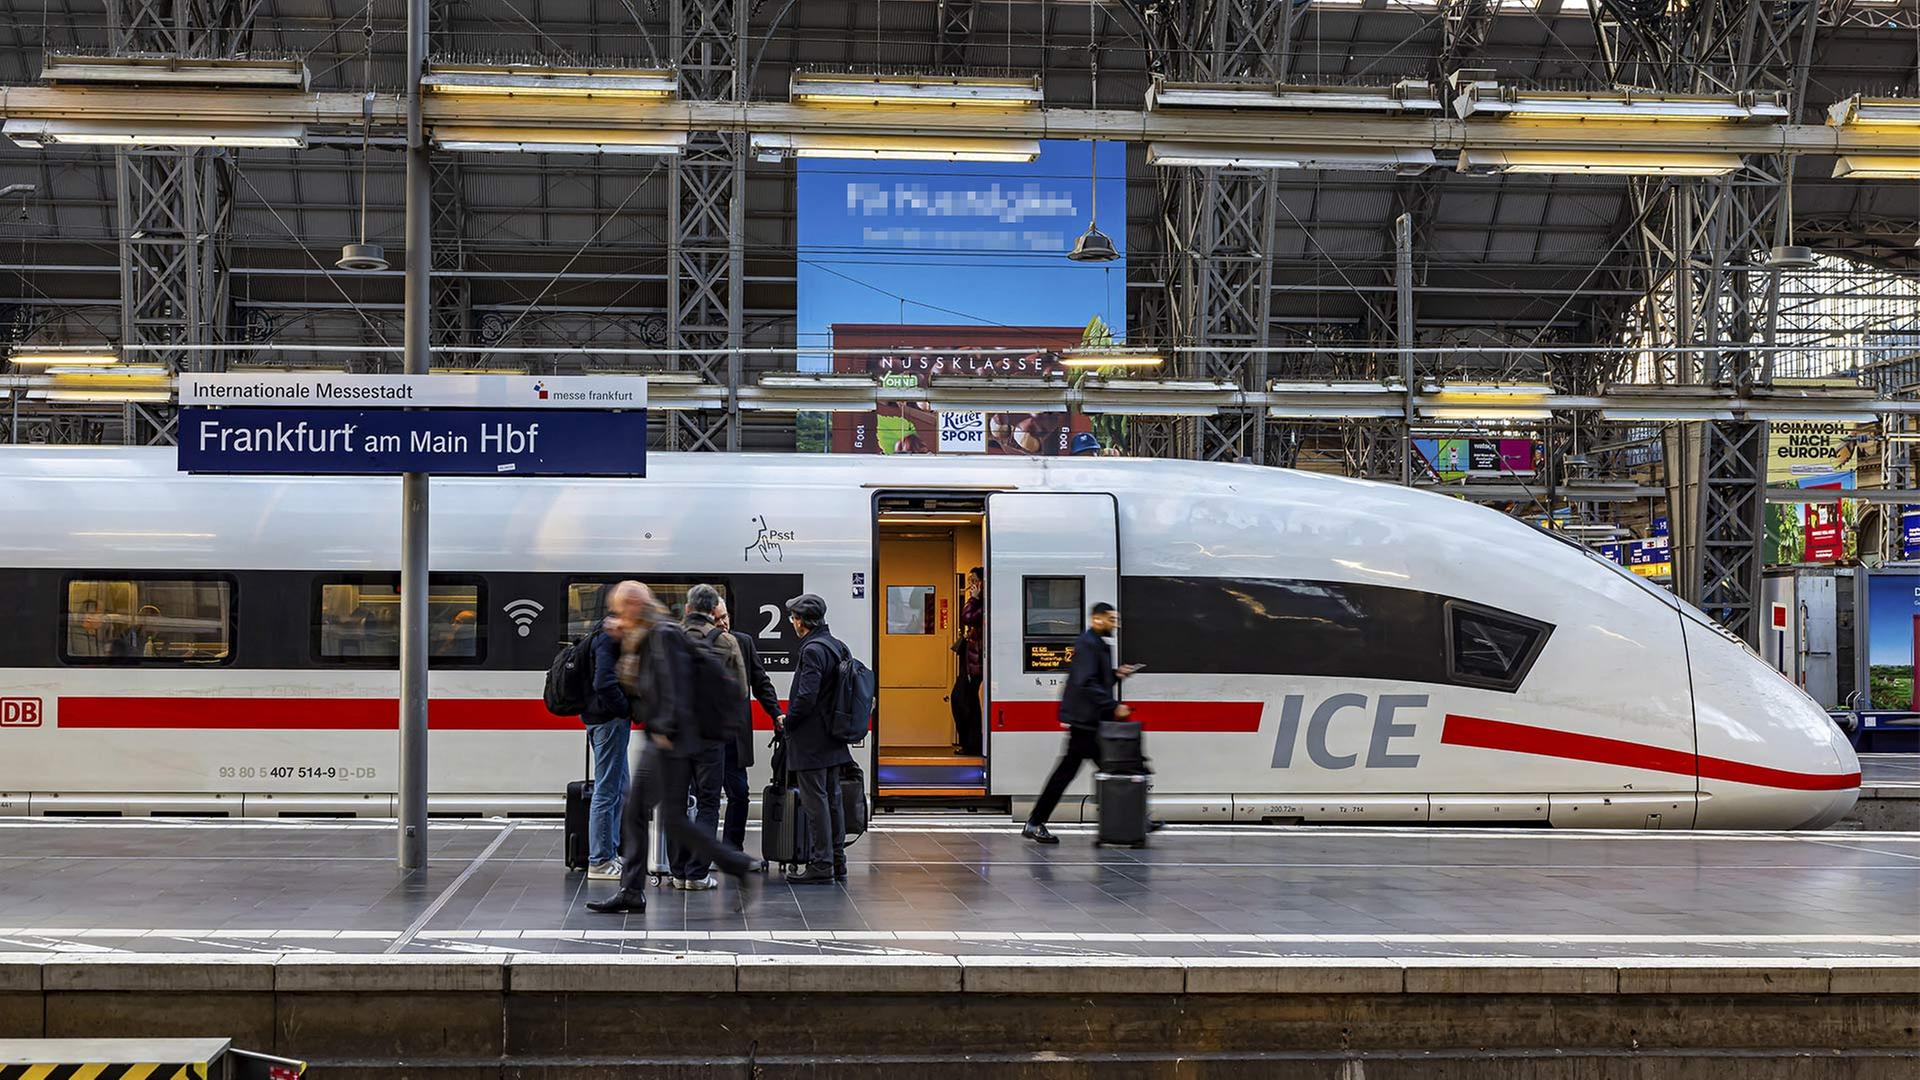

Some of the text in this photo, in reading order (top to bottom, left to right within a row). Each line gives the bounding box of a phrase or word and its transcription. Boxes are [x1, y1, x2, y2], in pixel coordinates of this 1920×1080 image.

[881, 357, 1042, 371] NUSSKLASSE
[193, 382, 414, 399] Internationale Messestadt
[553, 390, 633, 401] messe frankfurt
[941, 411, 982, 430] Ritter
[200, 420, 539, 454] Frankfurt am Main Hbf
[941, 430, 983, 442] SPORT
[1789, 434, 1830, 447] NACH
[769, 529, 795, 541] Psst
[758, 603, 782, 640] 2
[763, 657, 772, 665] 11
[780, 657, 790, 665] 68
[4, 702, 38, 723] DB
[1270, 692, 1430, 770] ICE
[218, 767, 377, 781] 93 80 5 407 514-9 D-DB
